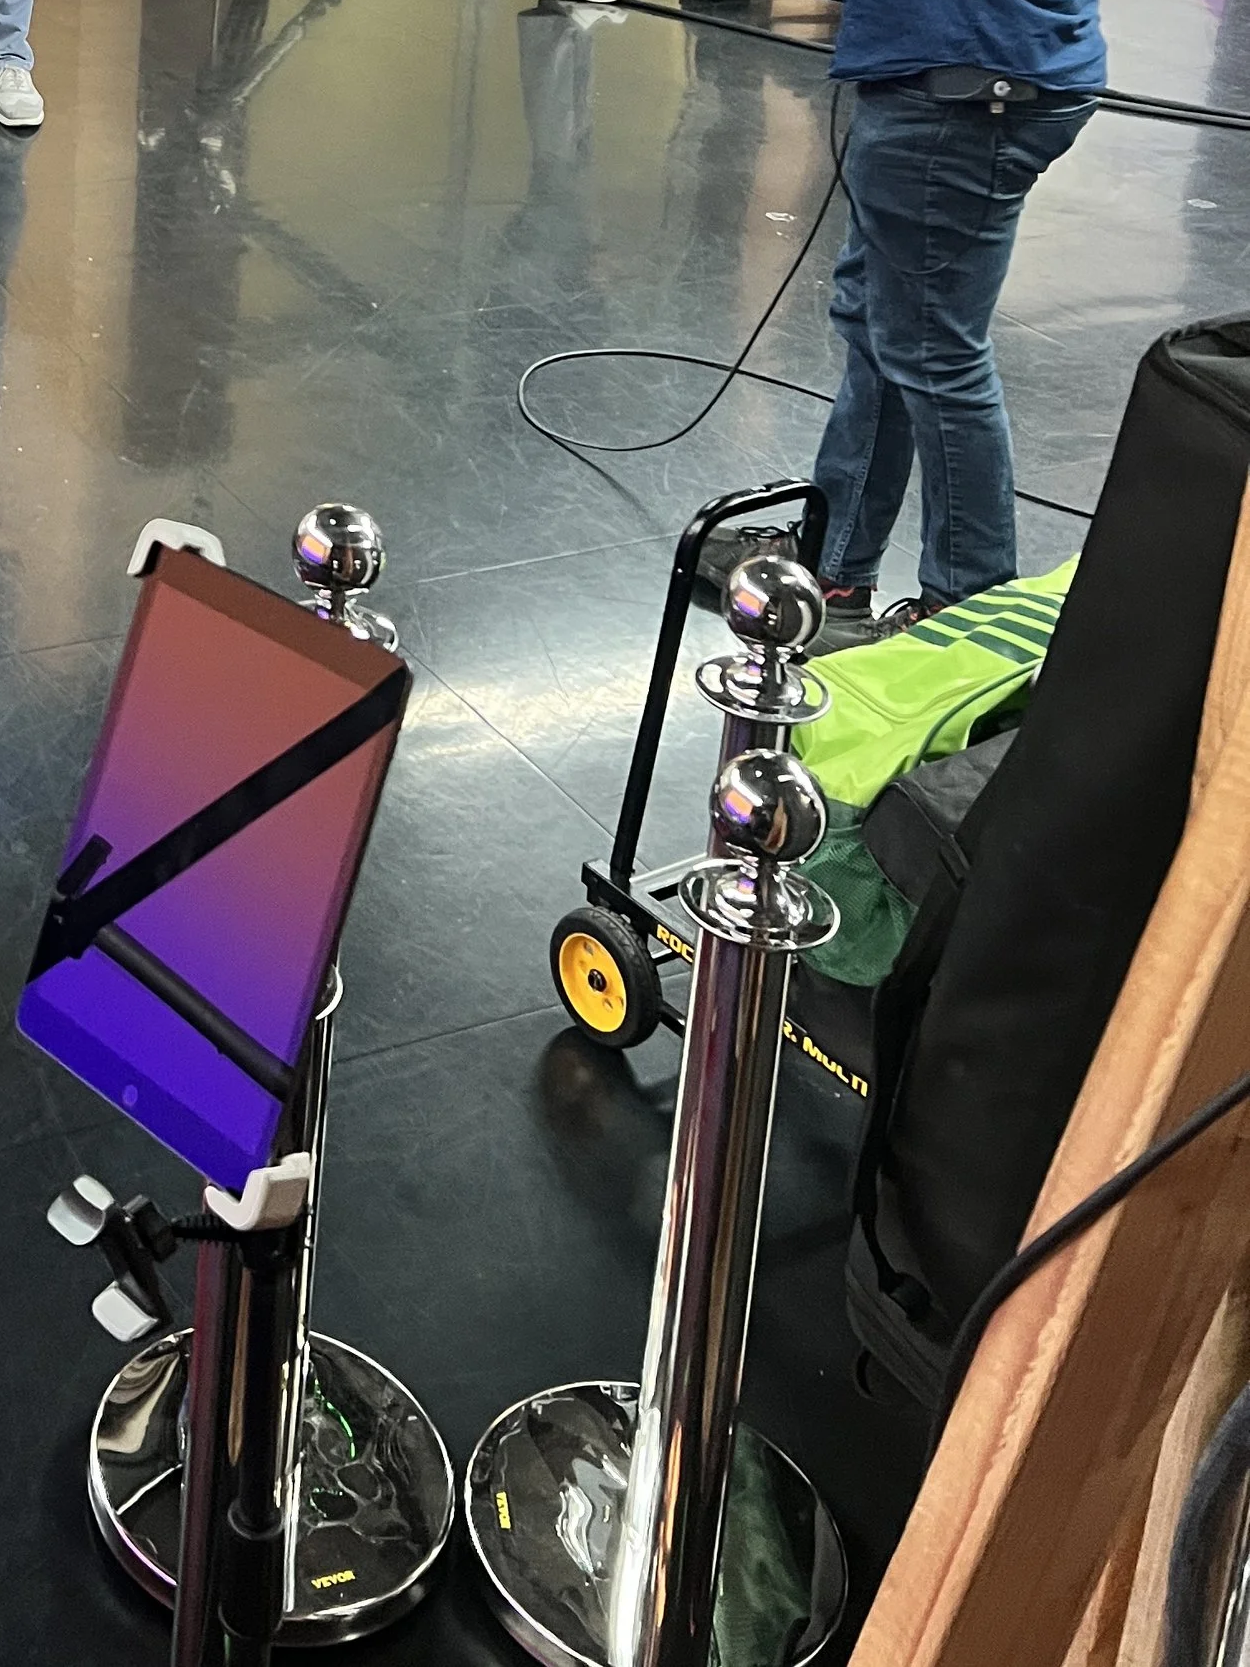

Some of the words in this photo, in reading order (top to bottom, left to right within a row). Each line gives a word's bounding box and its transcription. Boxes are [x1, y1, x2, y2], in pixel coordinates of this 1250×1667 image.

[657, 924, 695, 963] ROC
[803, 1036, 868, 1097] MULTI
[311, 1570, 356, 1589] VEVOR
